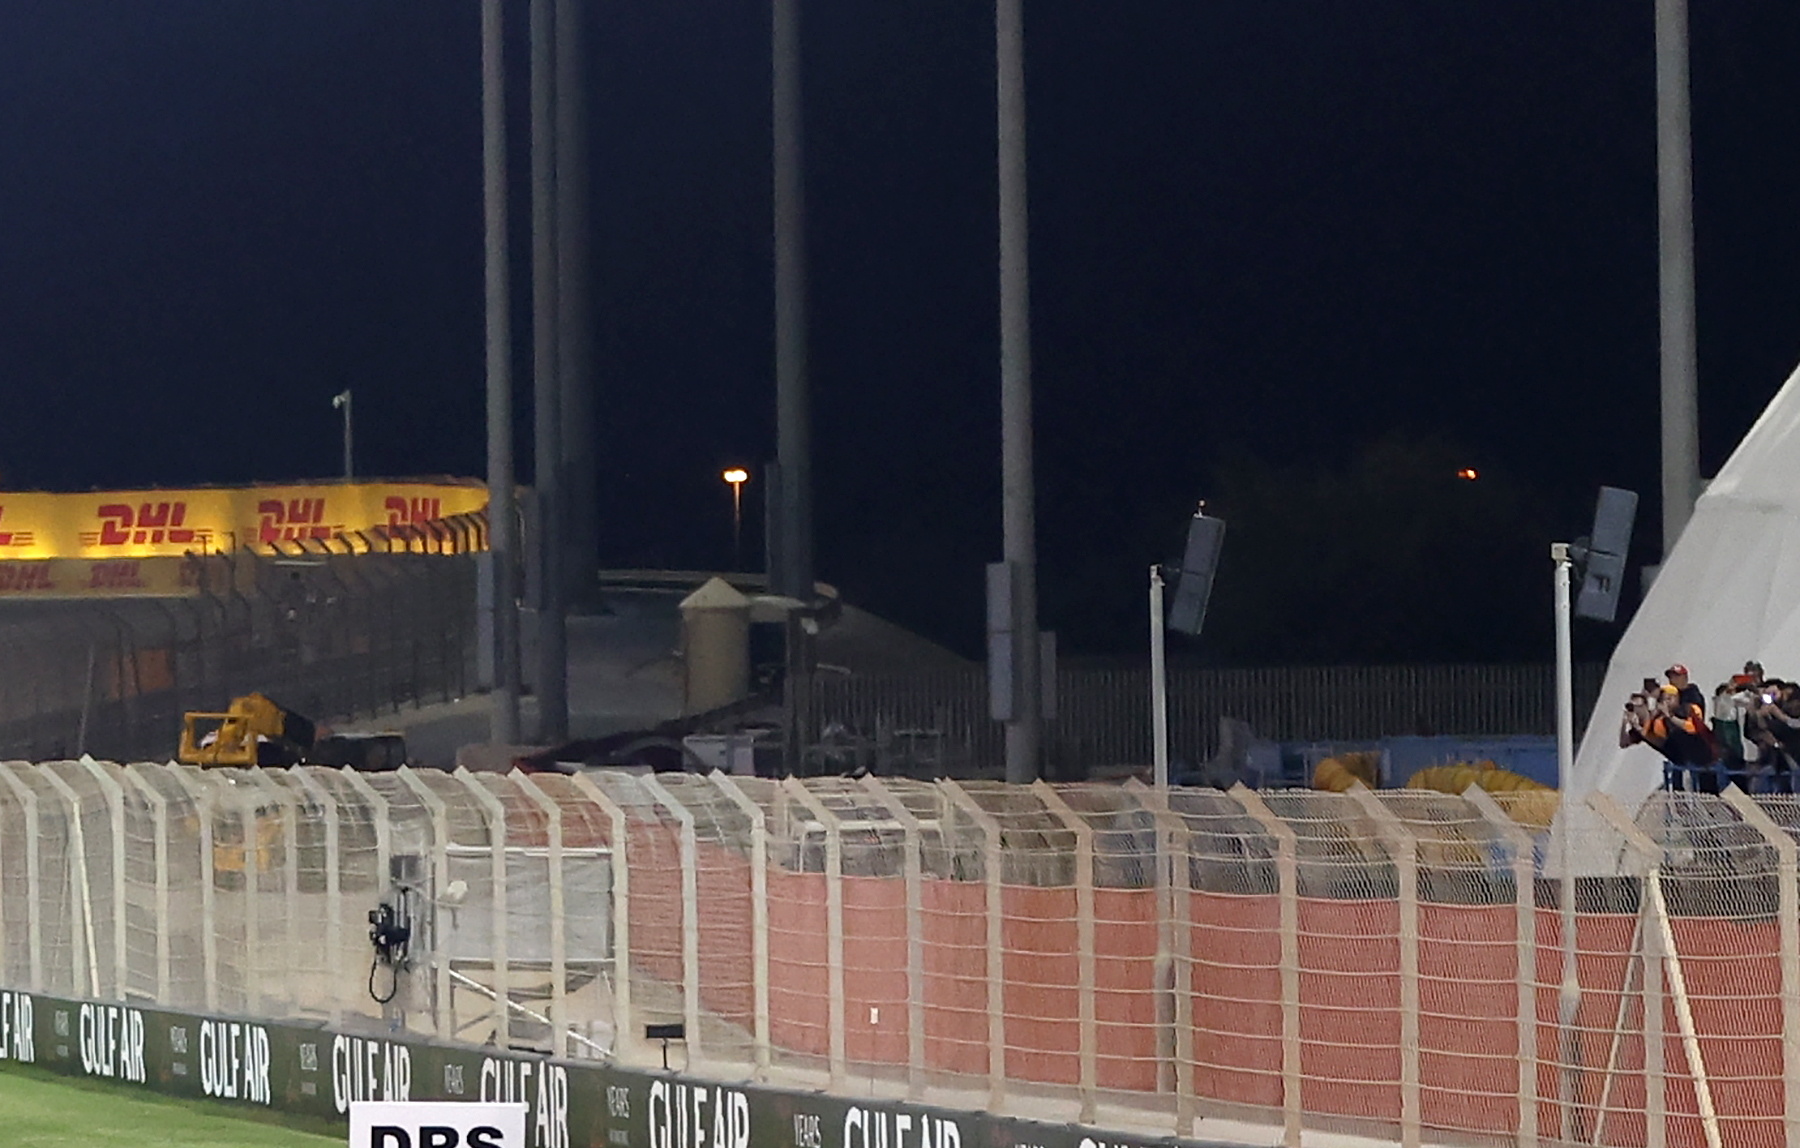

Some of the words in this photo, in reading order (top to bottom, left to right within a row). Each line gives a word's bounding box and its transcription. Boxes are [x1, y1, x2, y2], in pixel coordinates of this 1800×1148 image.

[98, 502, 194, 545] DHL
[258, 498, 331, 542] DHL
[13, 991, 35, 1063] AIR
[79, 1002, 118, 1077] GULF
[119, 1006, 146, 1083] AIR
[200, 1019, 241, 1098] GULF
[243, 1023, 271, 1105] AIR
[383, 1041, 411, 1102] AIR
